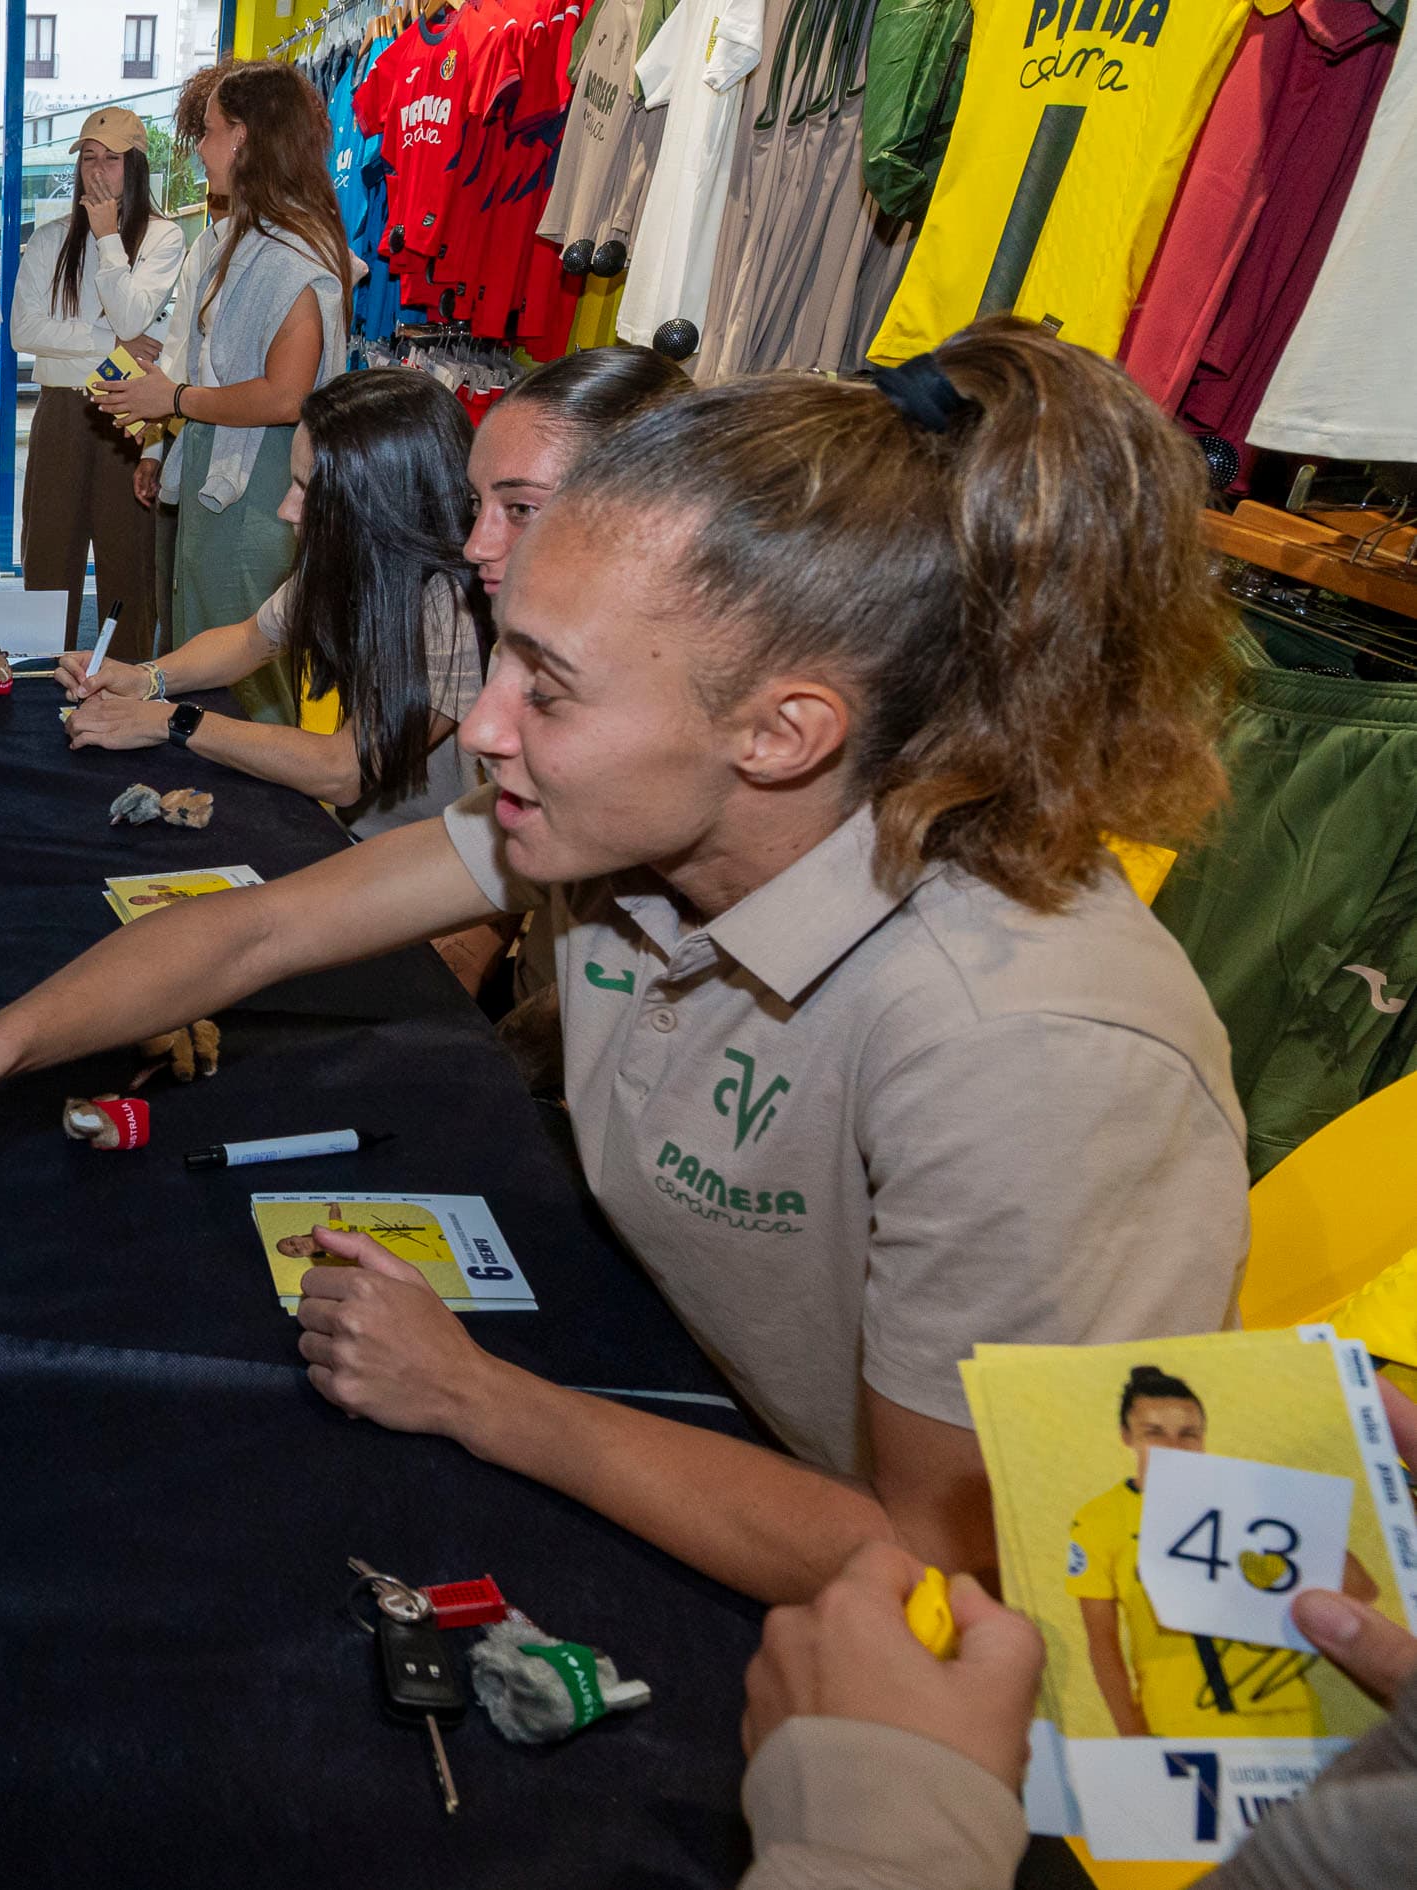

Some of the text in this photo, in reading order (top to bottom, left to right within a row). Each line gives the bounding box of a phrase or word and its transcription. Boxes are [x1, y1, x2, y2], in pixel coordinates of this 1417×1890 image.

[656, 1139, 807, 1215] PAMESA
[466, 1265, 515, 1282] 6
[473, 1237, 499, 1265] CIENFU
[1166, 1508, 1299, 1593] 43
[1164, 1752, 1220, 1843] 7
